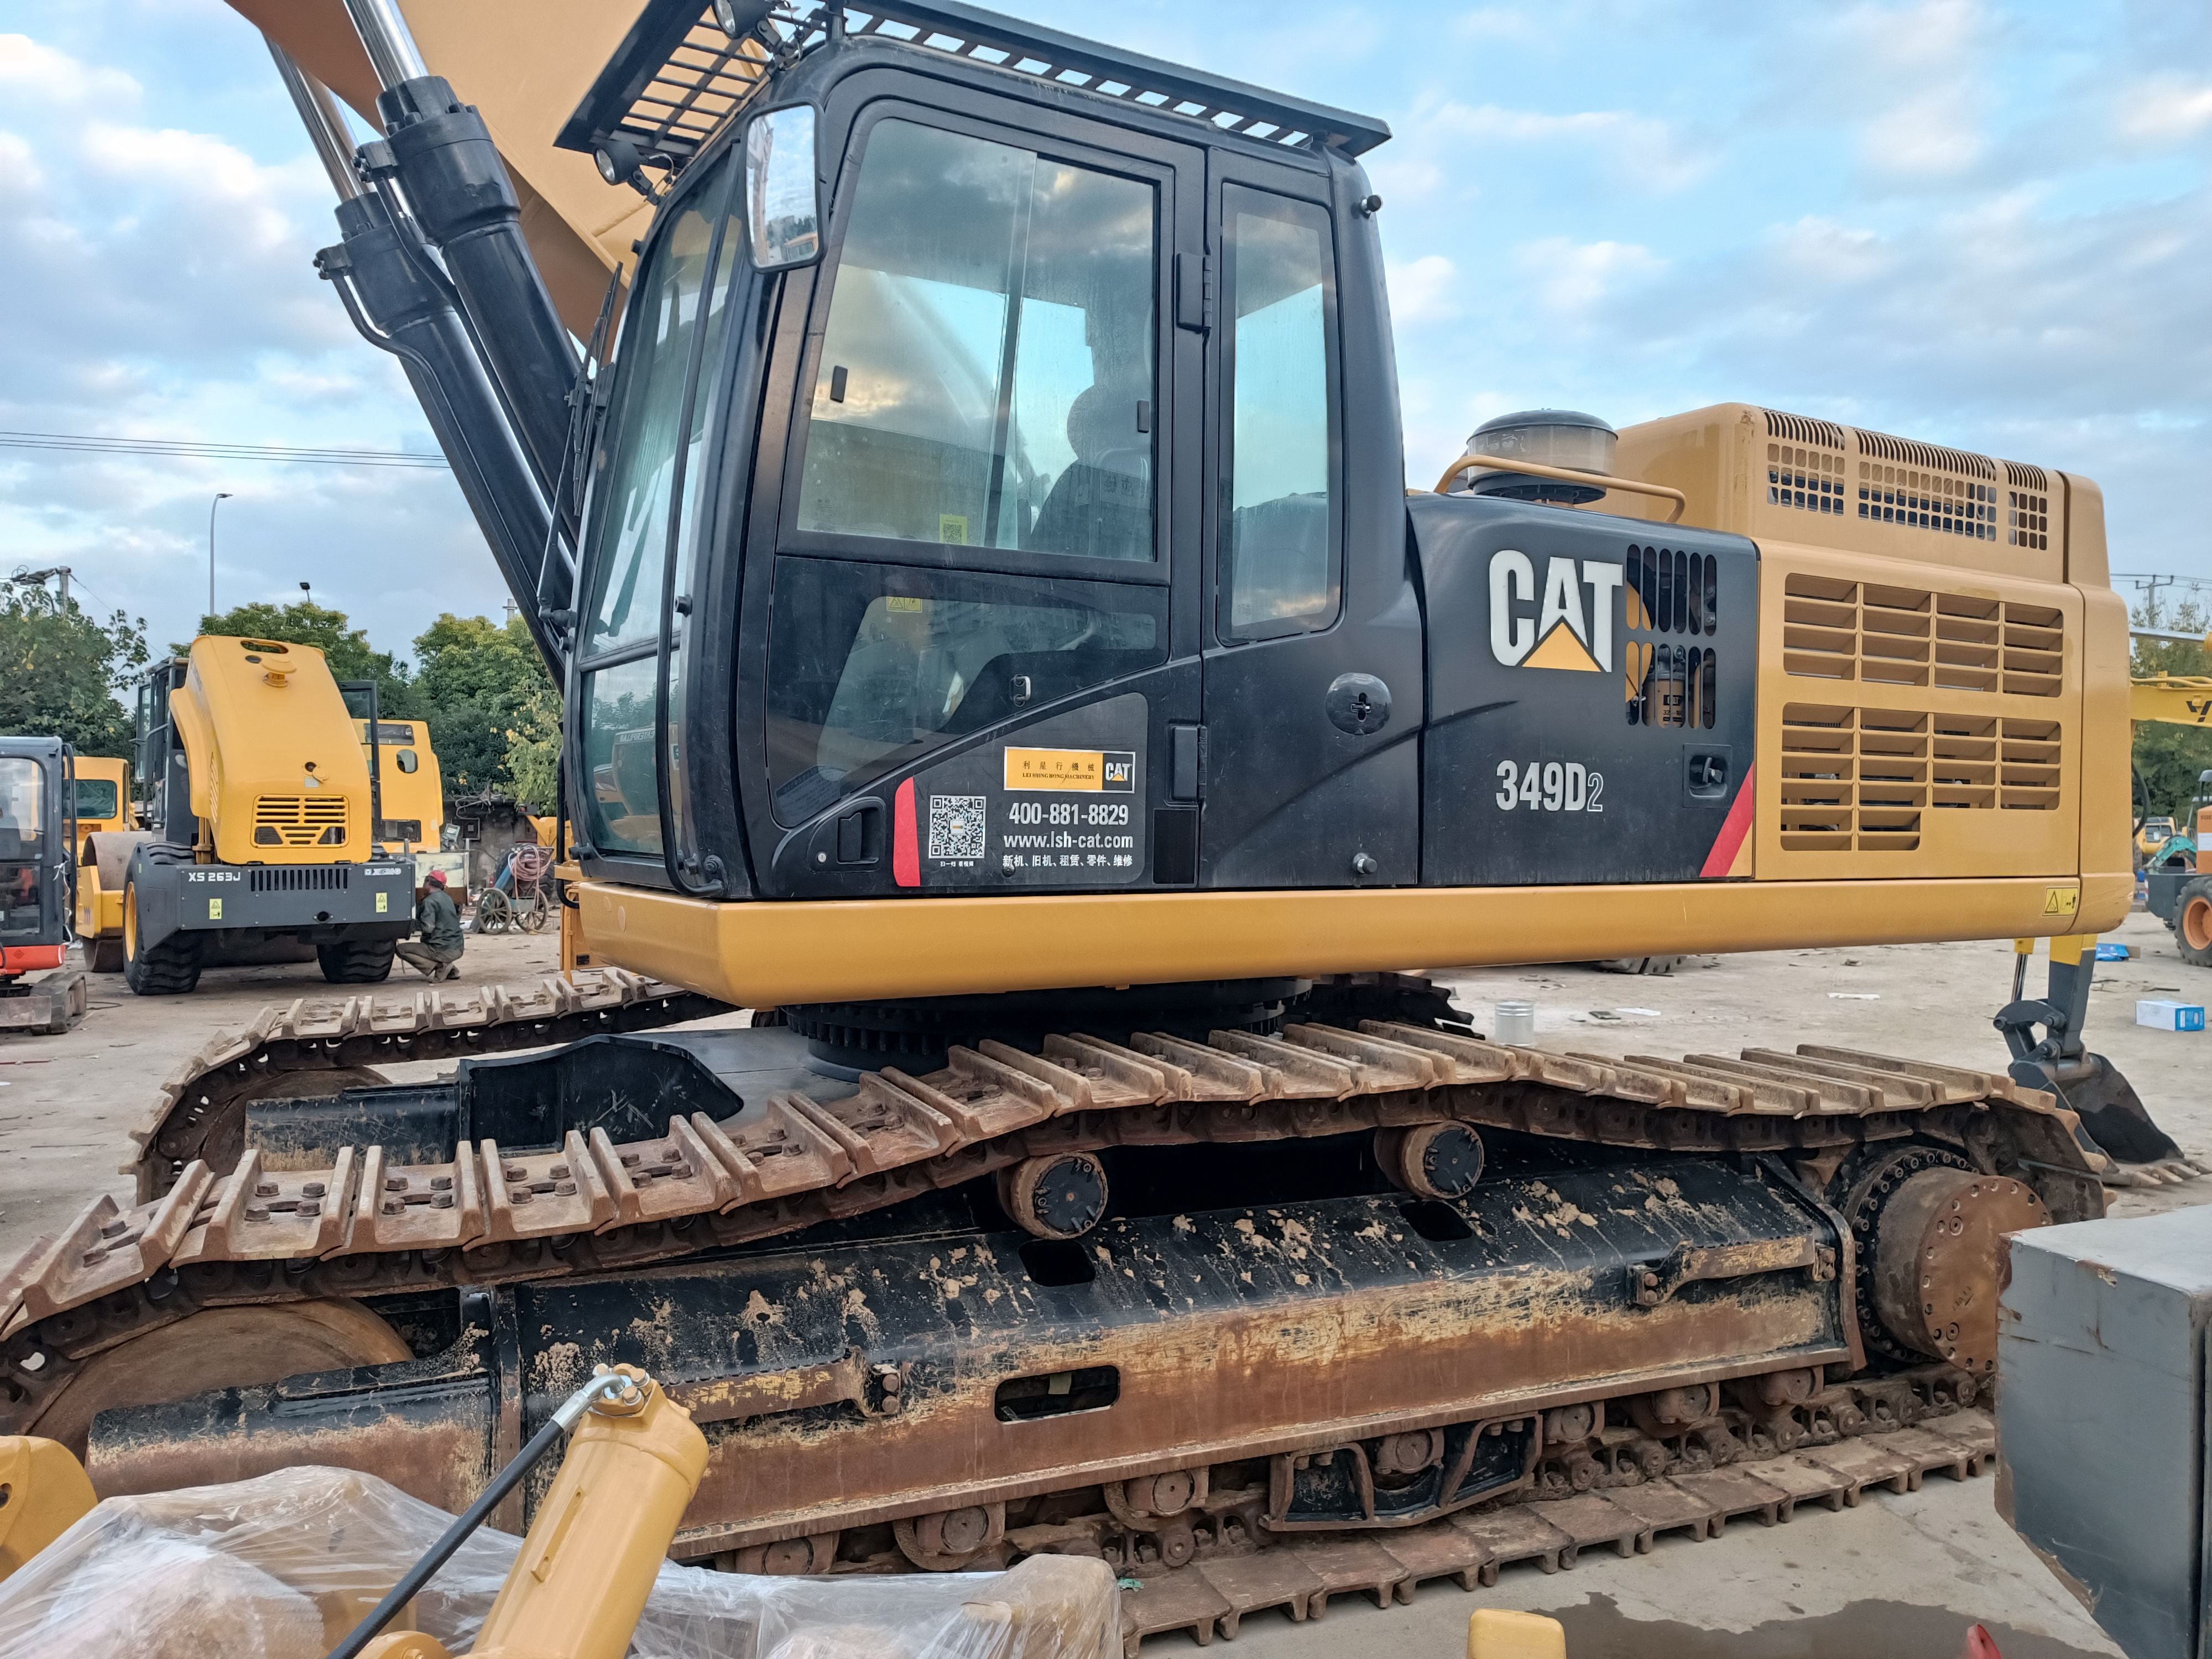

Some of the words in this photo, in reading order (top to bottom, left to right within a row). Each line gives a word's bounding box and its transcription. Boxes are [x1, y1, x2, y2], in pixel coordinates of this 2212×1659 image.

[1489, 550, 1623, 672] CAT
[1105, 762, 1130, 781] CAT
[1496, 760, 1603, 812] 349D2
[1009, 802, 1129, 825] 400-881-8829
[1004, 831, 1133, 848] www.lsh-cat.com
[1003, 854, 1133, 867] 新机、旧机、租赁、零件、维修
[188, 872, 205, 882] XS
[208, 872, 241, 881] 263J
